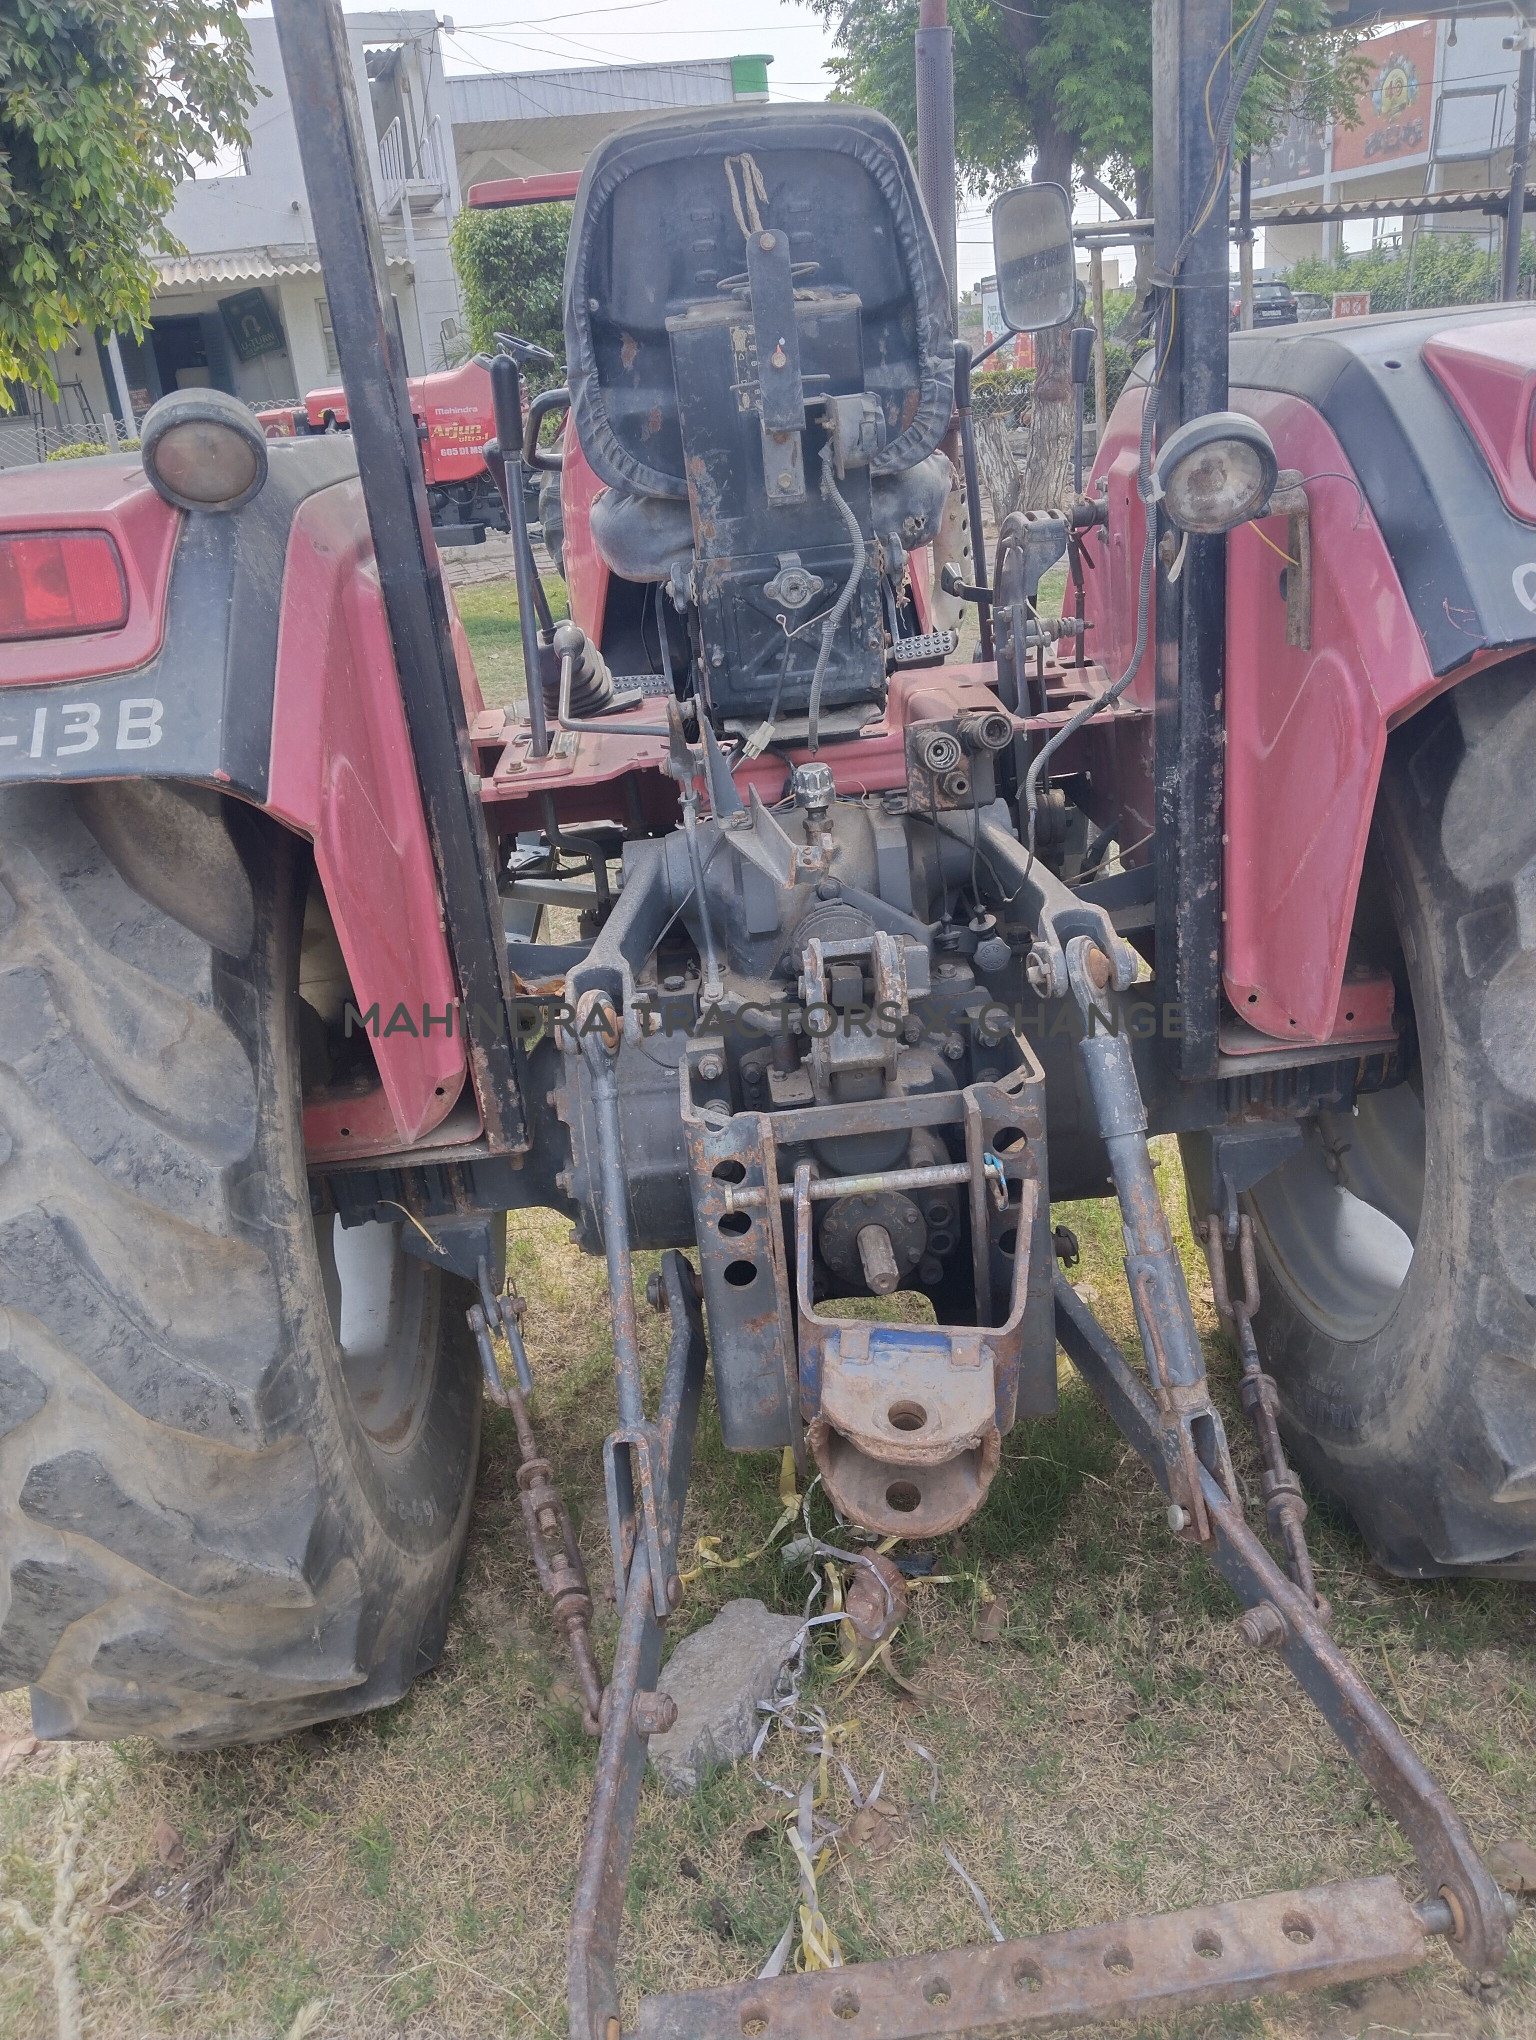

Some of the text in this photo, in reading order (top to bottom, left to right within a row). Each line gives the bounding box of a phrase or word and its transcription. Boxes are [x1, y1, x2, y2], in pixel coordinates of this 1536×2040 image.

[435, 406, 478, 415] Mahindra
[431, 422, 481, 439] Arjun
[440, 447, 458, 456] 605
[470, 446, 483, 454] MS
